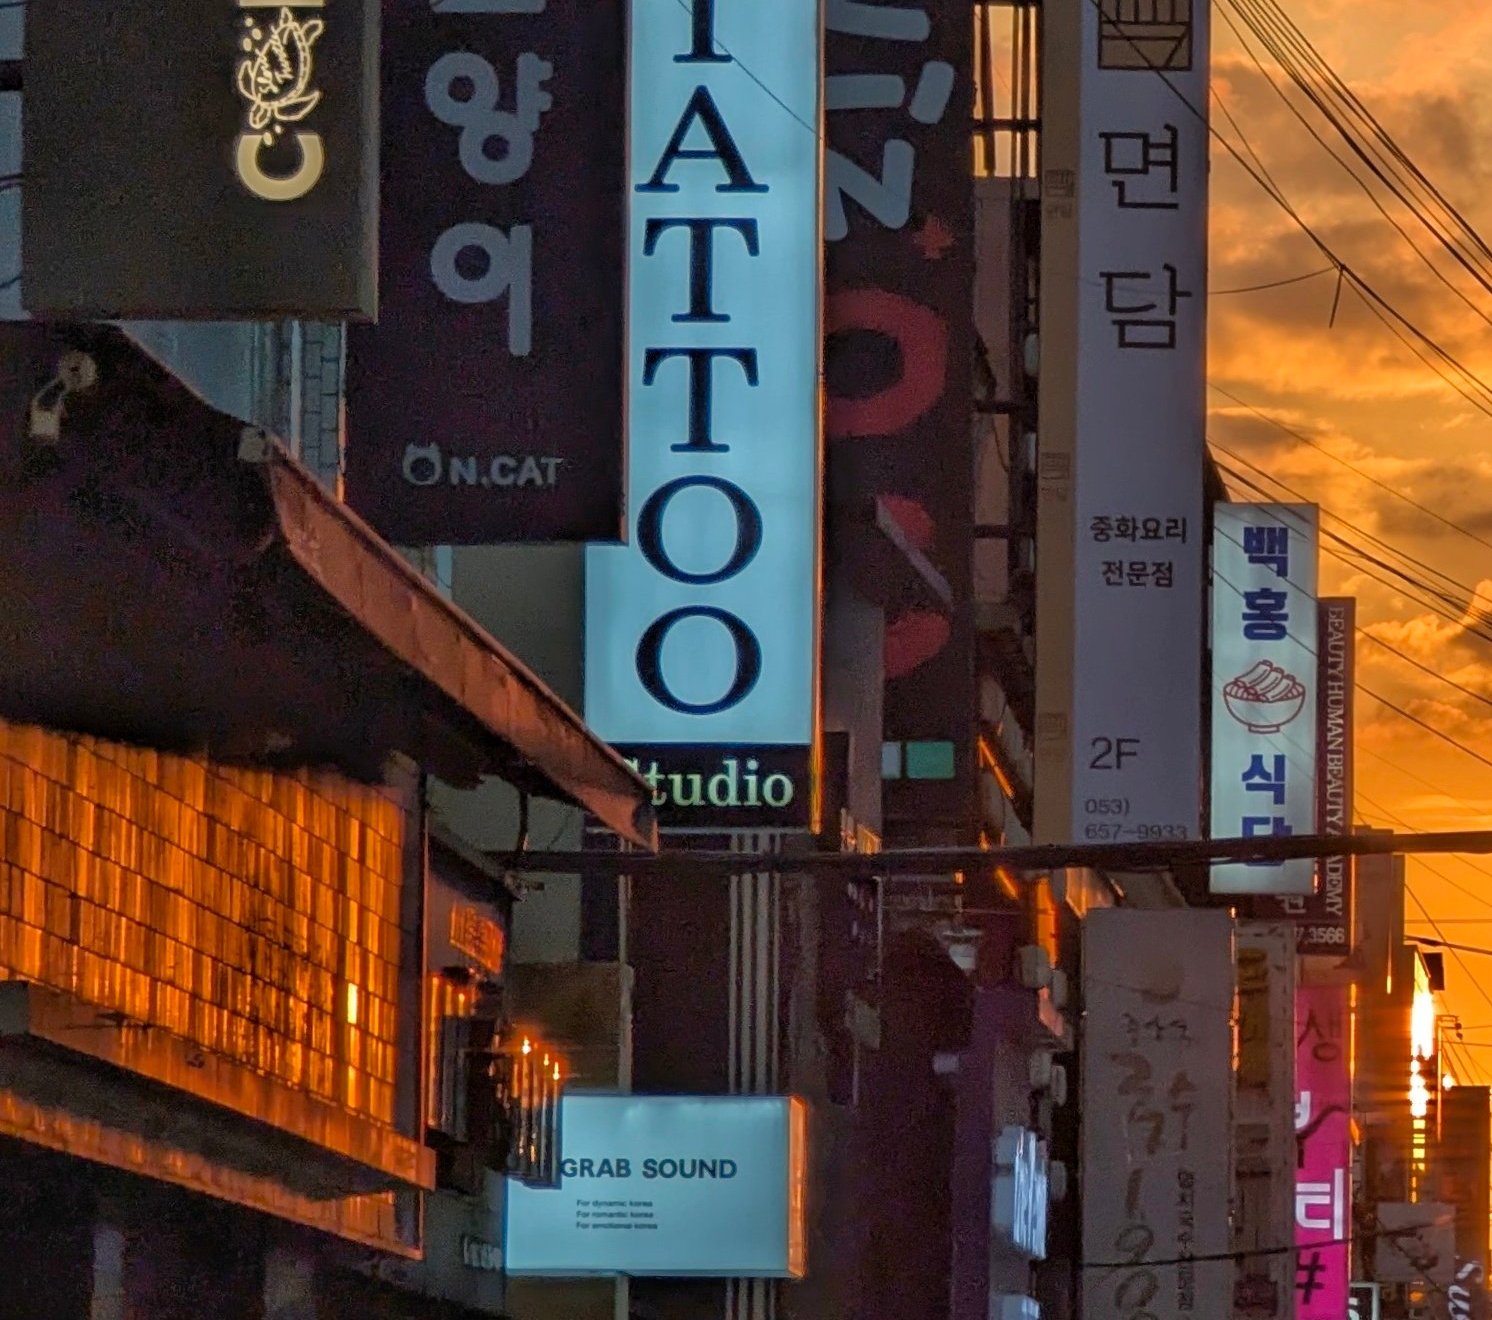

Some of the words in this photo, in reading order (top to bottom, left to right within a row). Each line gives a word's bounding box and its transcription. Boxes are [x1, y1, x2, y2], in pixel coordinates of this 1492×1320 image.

[1089, 515, 1188, 544] 중화요리
[1102, 560, 1174, 588] 전문점
[1327, 680, 1345, 750] HUMAN
[1089, 737, 1140, 770] 2F
[1326, 753, 1345, 829] BEAUTY
[561, 1157, 631, 1178] GRAB
[642, 1157, 738, 1179] SOUND
